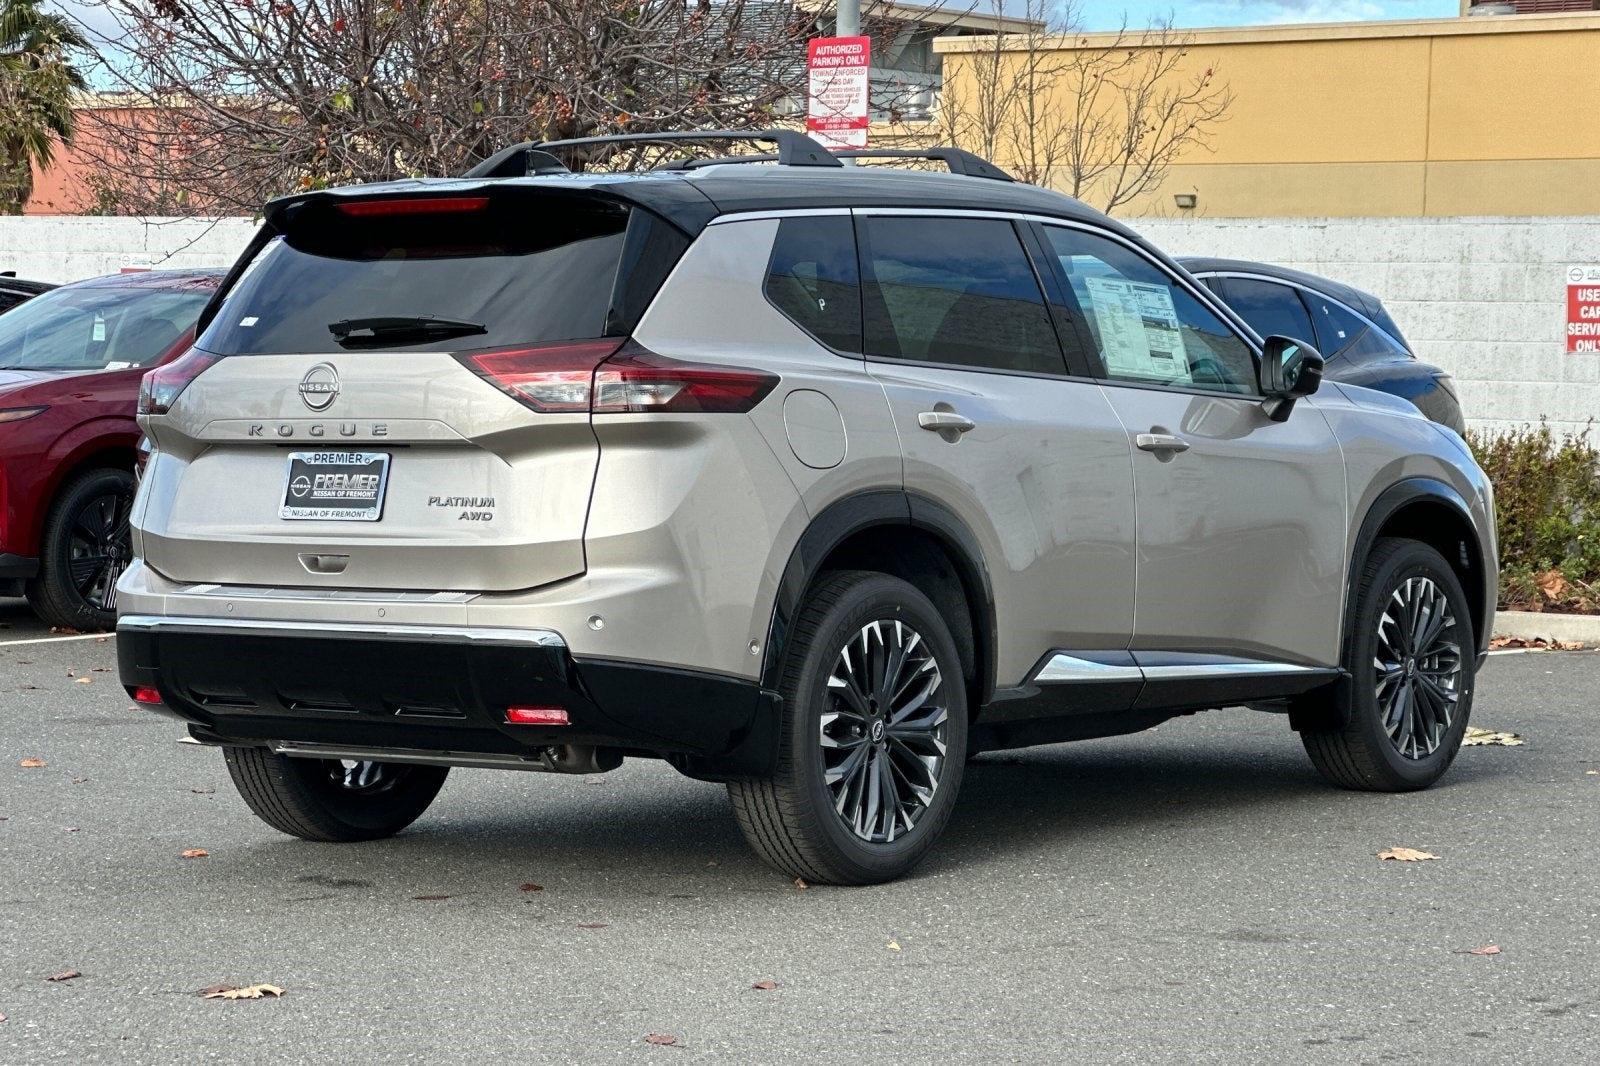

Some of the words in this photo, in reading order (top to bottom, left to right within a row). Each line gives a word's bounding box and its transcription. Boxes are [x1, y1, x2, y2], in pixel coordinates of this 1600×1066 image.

[815, 44, 863, 55] AUTHORIZED
[812, 56, 844, 67] PARKING
[845, 55, 866, 65] ONLY
[812, 69, 834, 78] TOWING
[835, 68, 866, 77] ENFORCED
[299, 383, 339, 393] NISSAN
[249, 423, 388, 437] ROGUE
[313, 453, 363, 464] PREMIER
[313, 474, 379, 490] PREMIER
[346, 490, 376, 498] FREMONT
[428, 496, 495, 508] PLATINUM
[291, 510, 319, 518] NISSAN
[319, 510, 329, 518] OF
[331, 510, 367, 518] FREMONT
[458, 511, 493, 522] AWD
